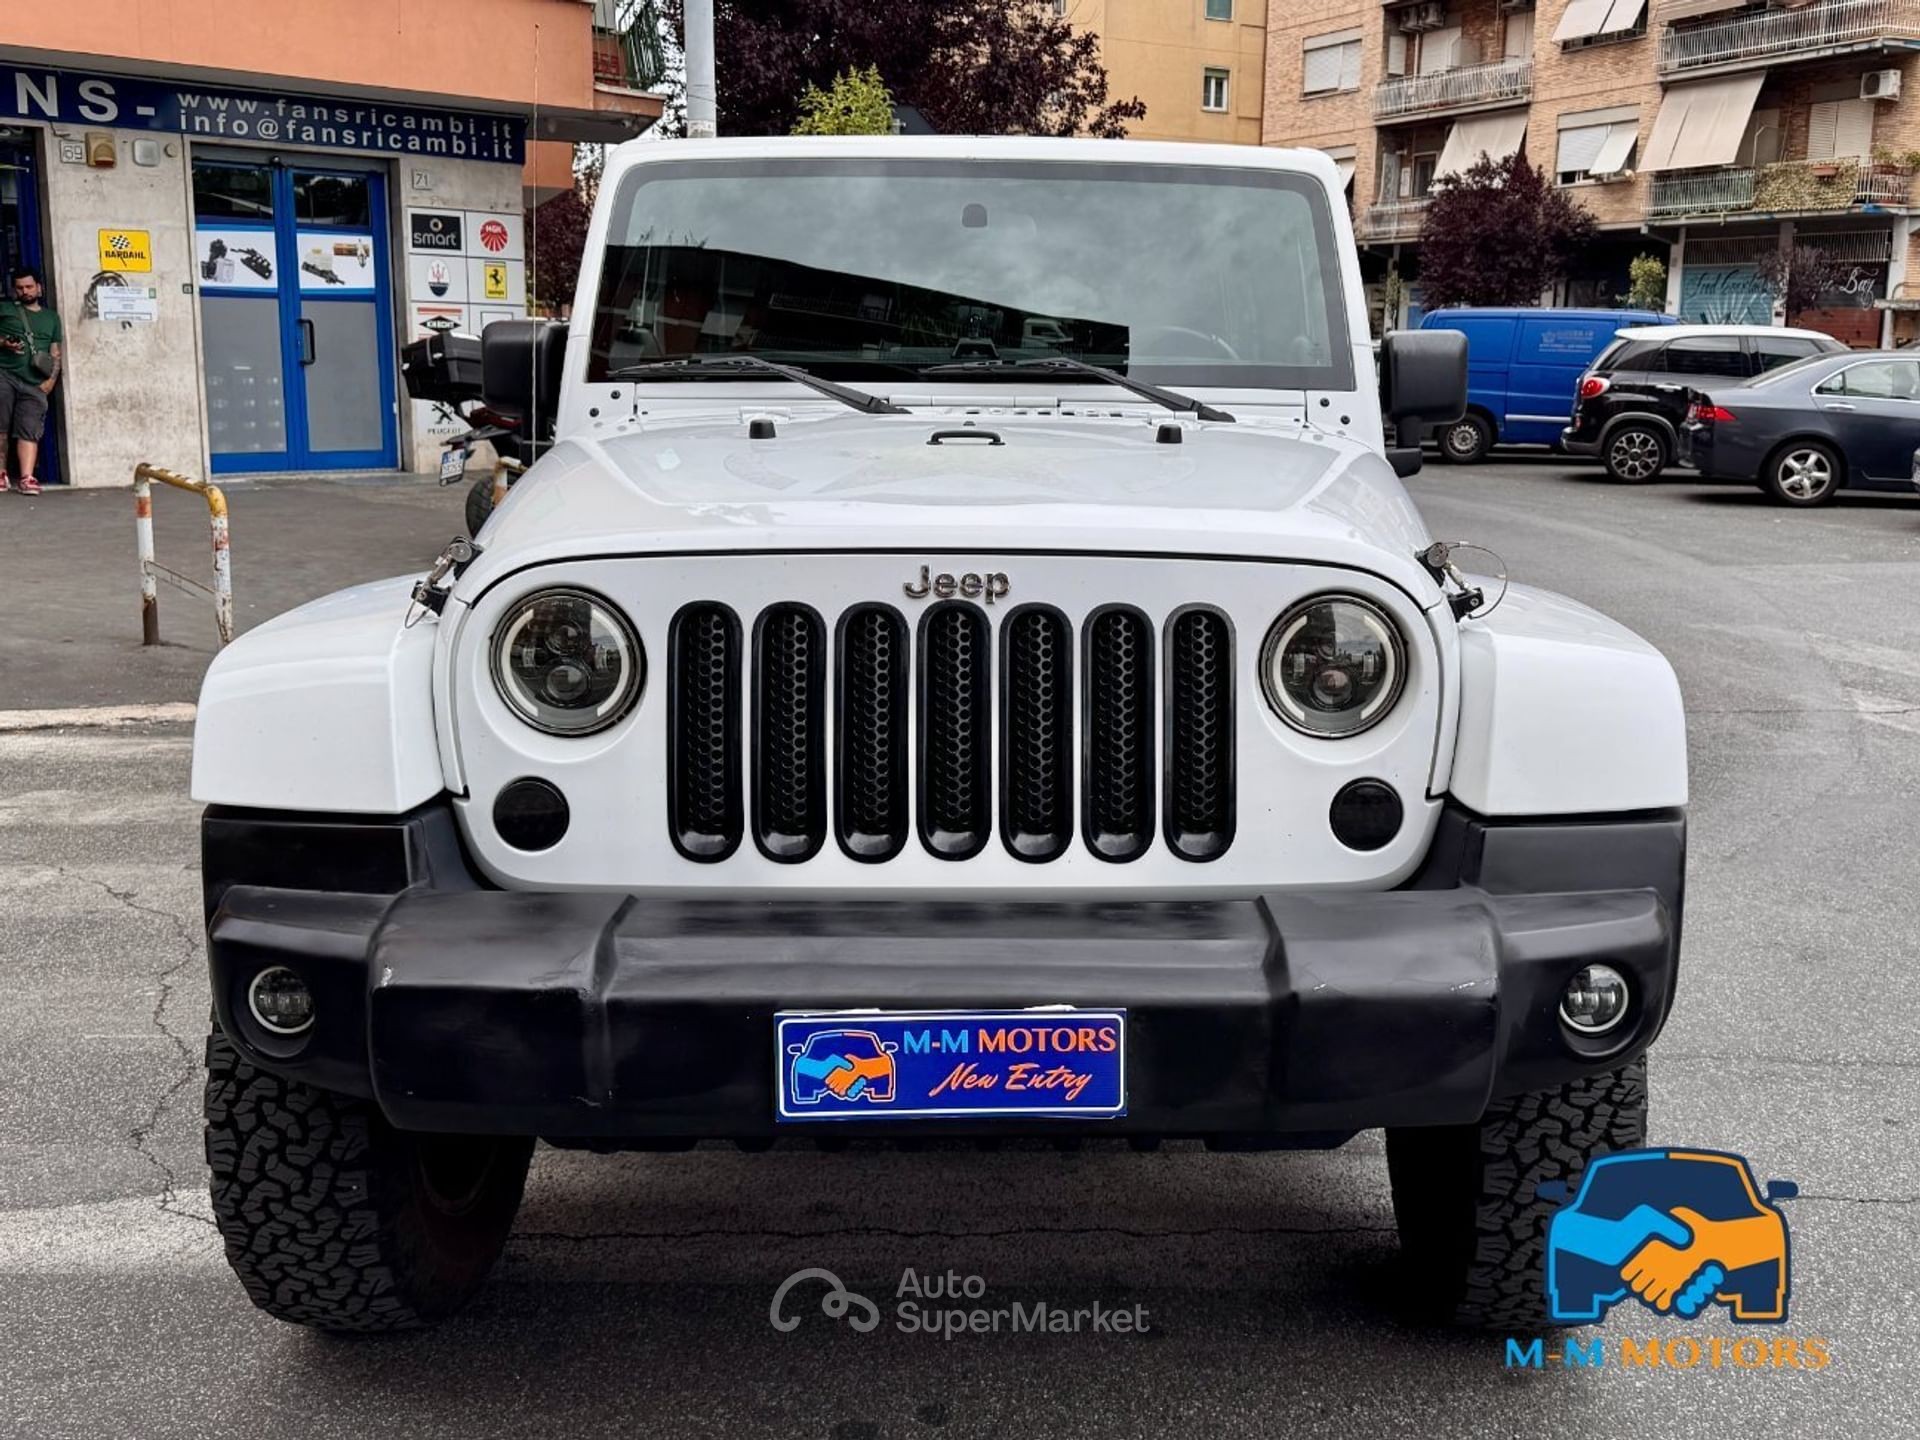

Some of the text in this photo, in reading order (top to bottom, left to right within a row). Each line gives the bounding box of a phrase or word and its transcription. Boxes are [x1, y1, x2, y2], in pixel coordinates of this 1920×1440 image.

[176, 92, 513, 139] www.fansricambi.it
[180, 109, 514, 160] info@fansricambi.it
[415, 172, 428, 187] 71
[105, 250, 147, 260] BARDAHL
[413, 232, 457, 246] smart
[903, 564, 1010, 604] Jeep
[903, 1027, 1116, 1054] M-M MOTORS
[929, 1062, 1092, 1101] New Entry
